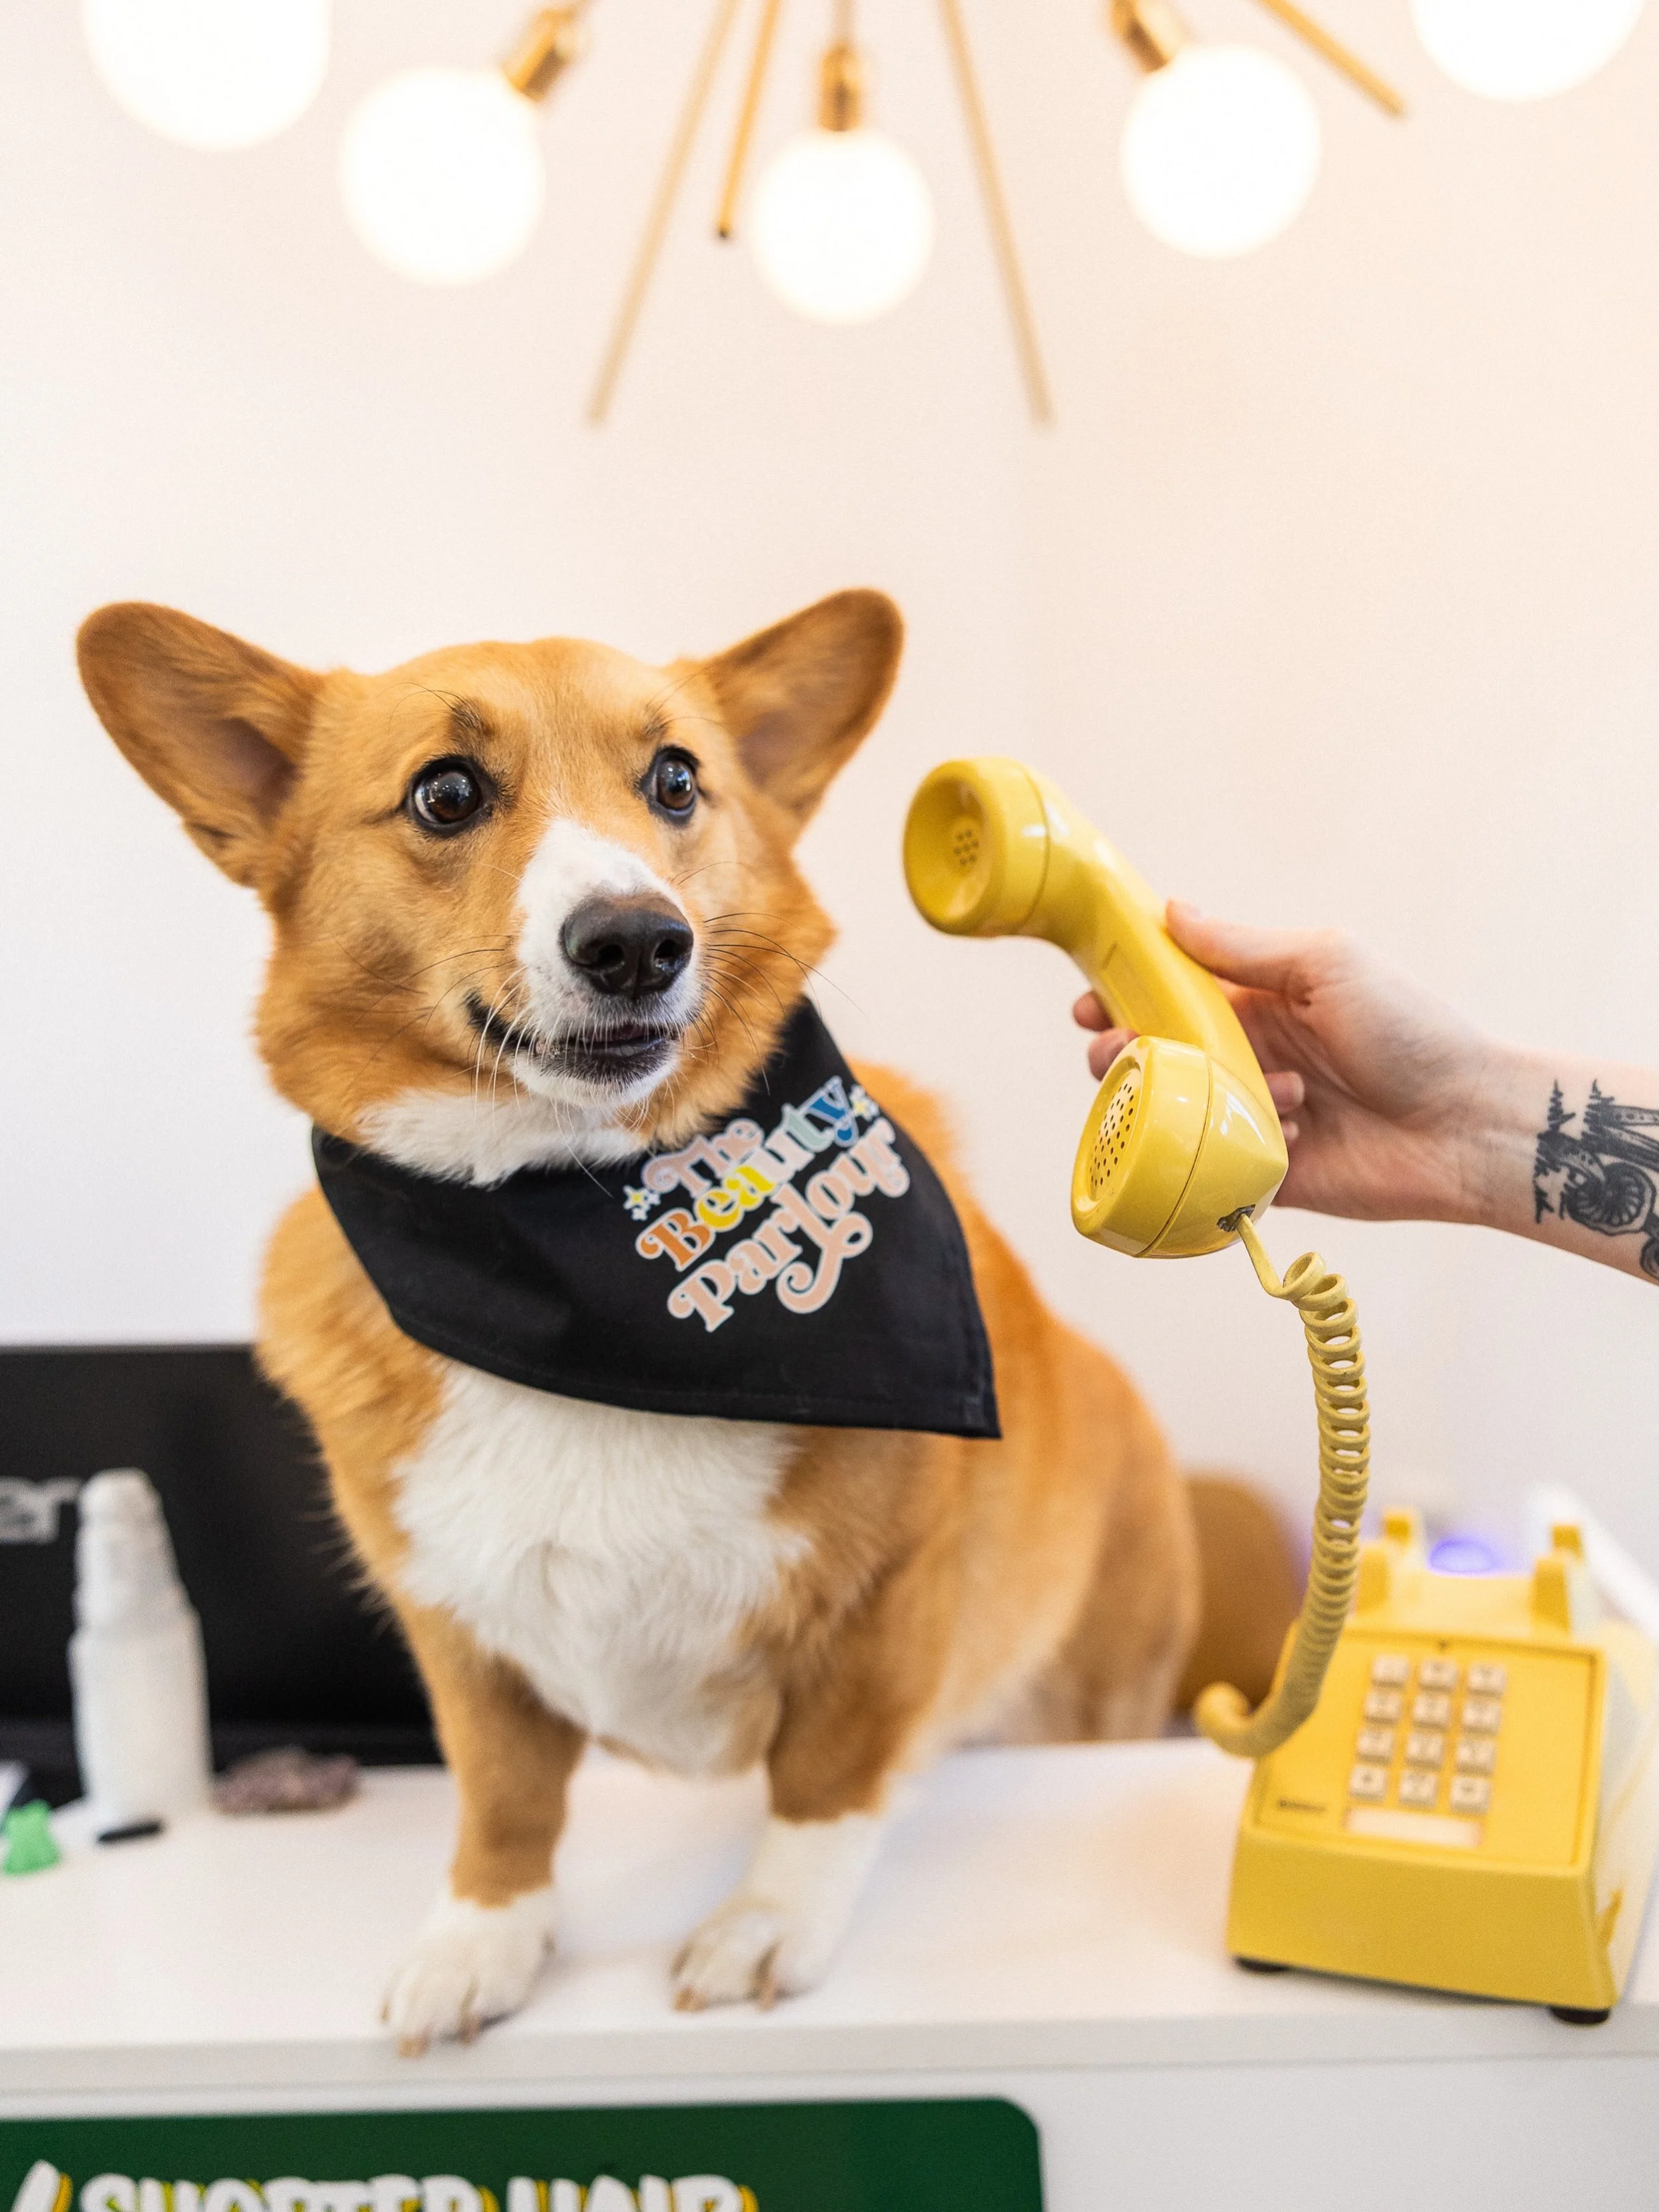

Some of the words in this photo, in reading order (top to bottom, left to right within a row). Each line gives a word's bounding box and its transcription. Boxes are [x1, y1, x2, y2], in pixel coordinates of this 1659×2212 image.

[636, 1076, 859, 1272] Beauty
[642, 1118, 764, 1198] The
[667, 1118, 910, 1332] Parlour
